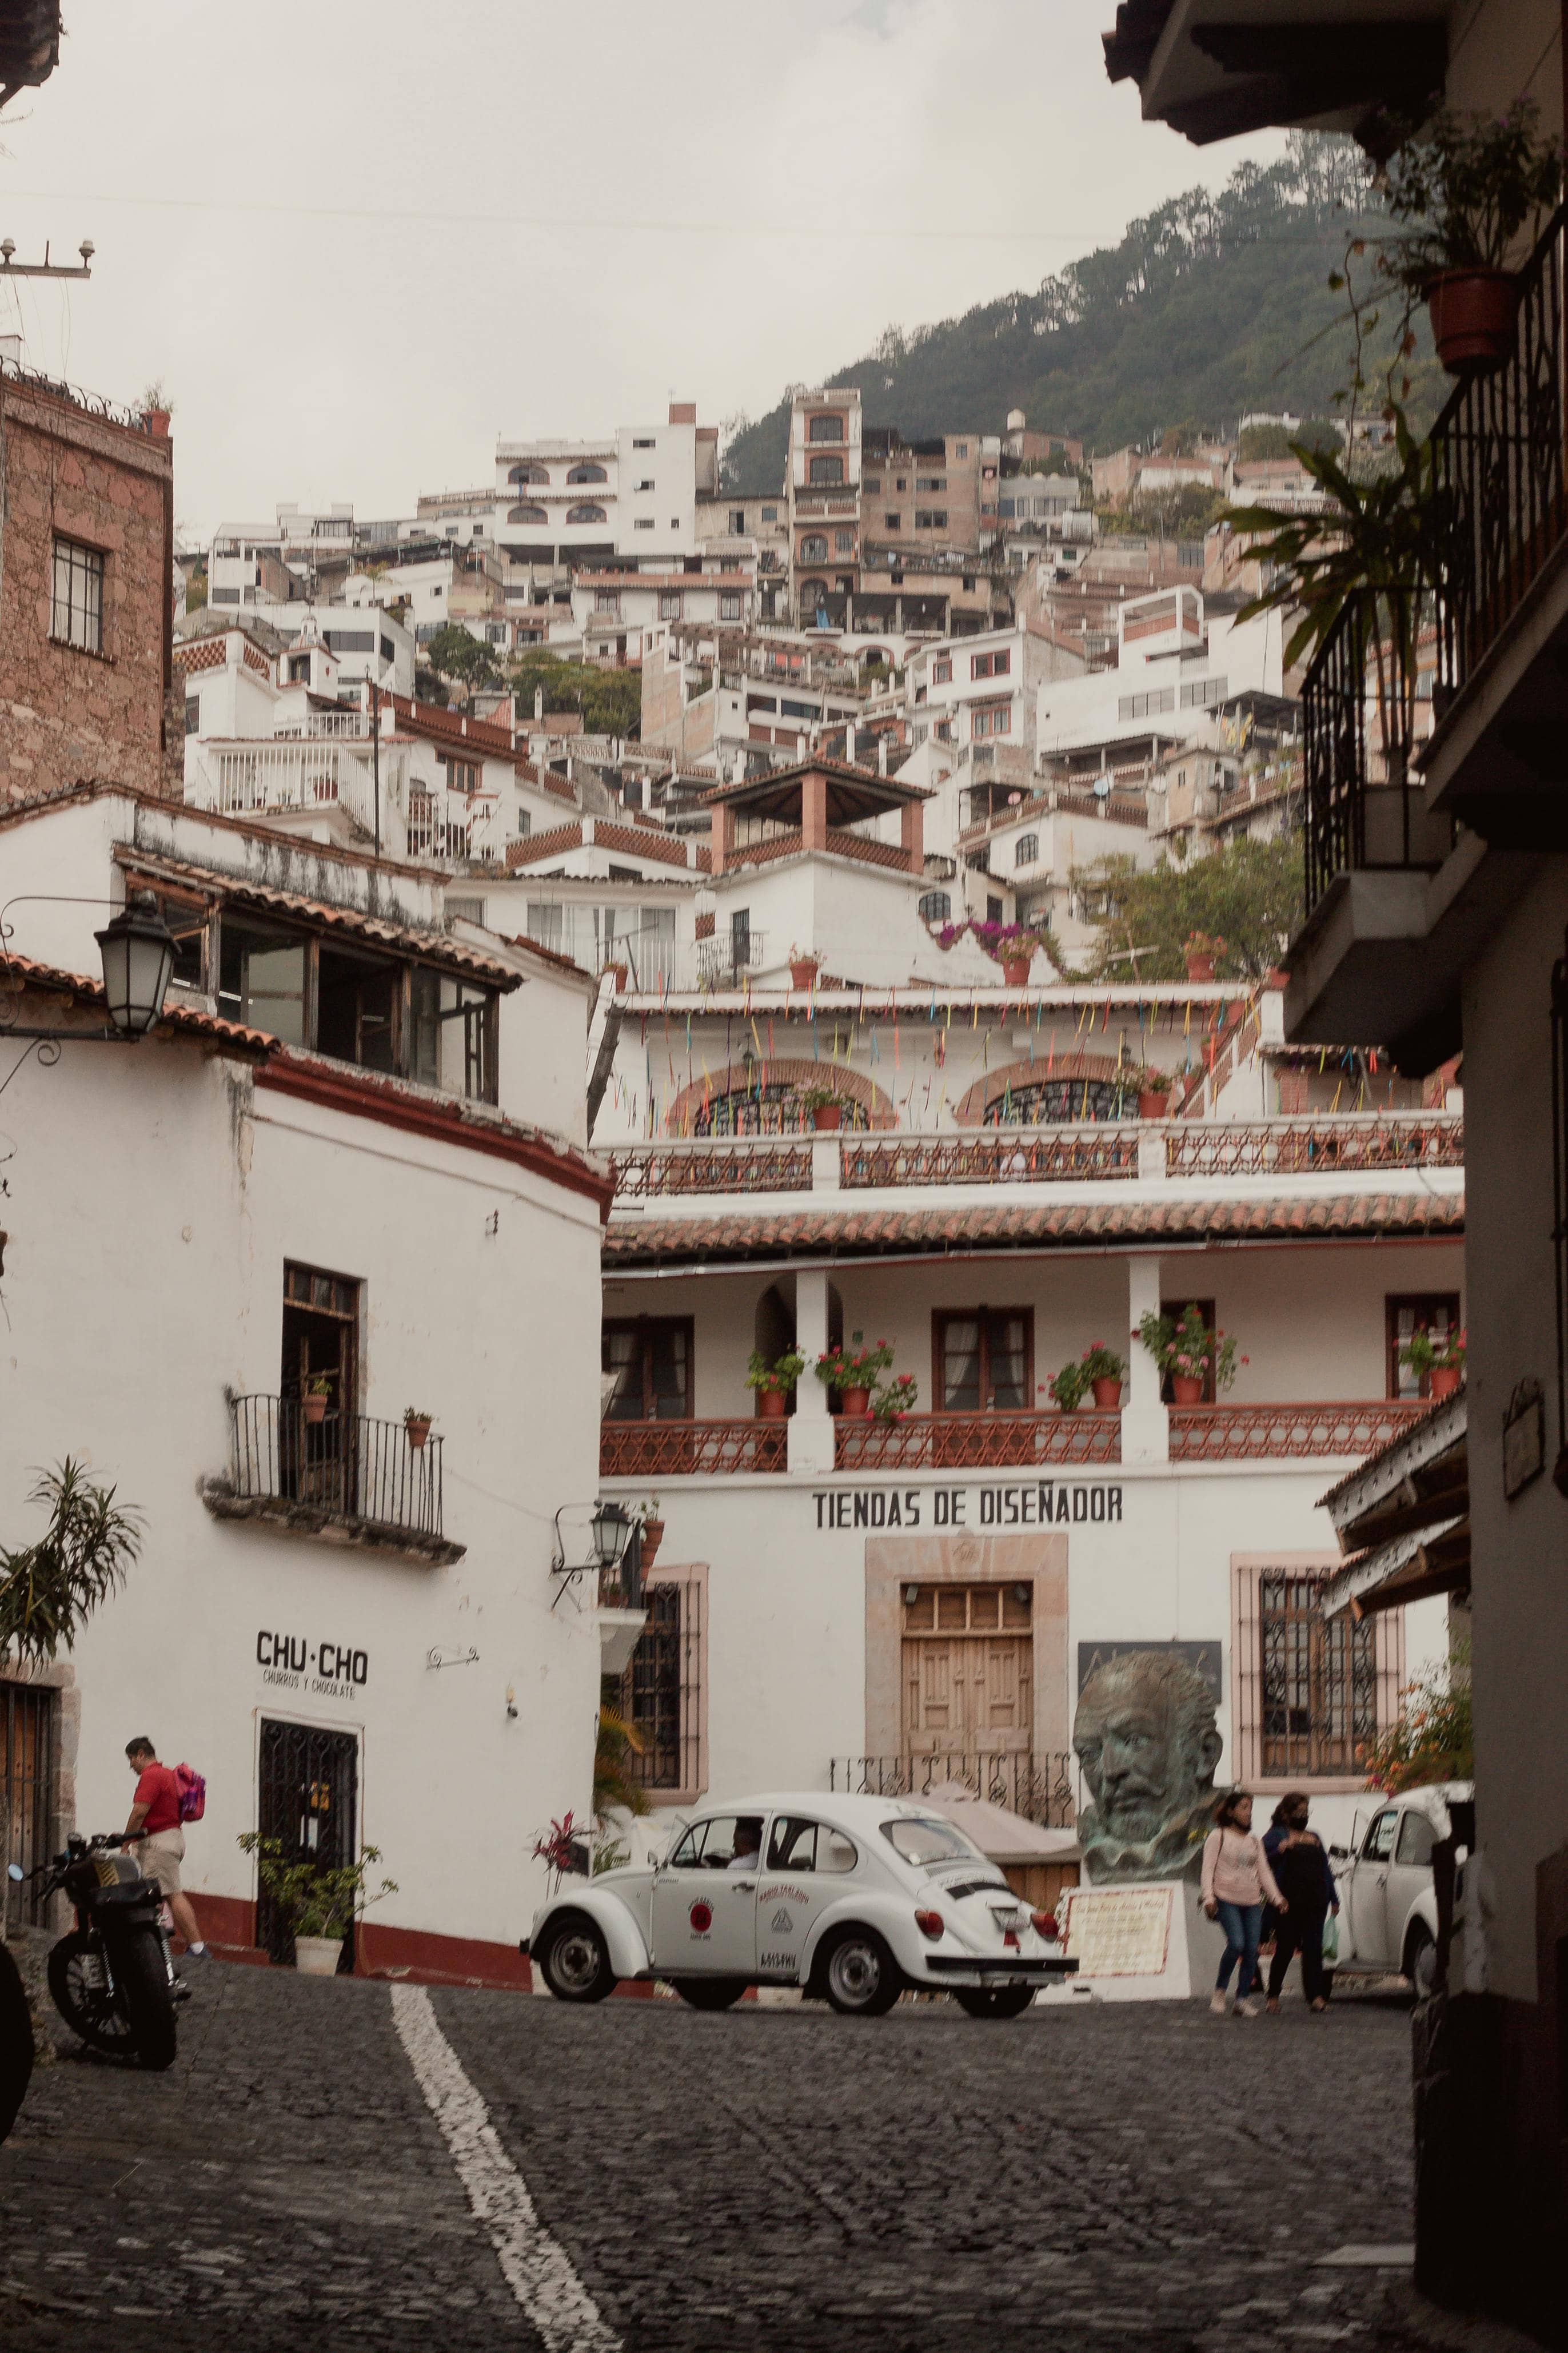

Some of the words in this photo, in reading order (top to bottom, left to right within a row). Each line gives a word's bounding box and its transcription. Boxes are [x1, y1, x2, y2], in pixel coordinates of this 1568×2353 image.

[812, 1491, 920, 1528] TIENDAS
[933, 1490, 966, 1525] DE
[980, 1480, 1122, 1524] DISEÑADOR
[263, 1669, 299, 1689] CHURROS
[304, 1676, 309, 1691] Y
